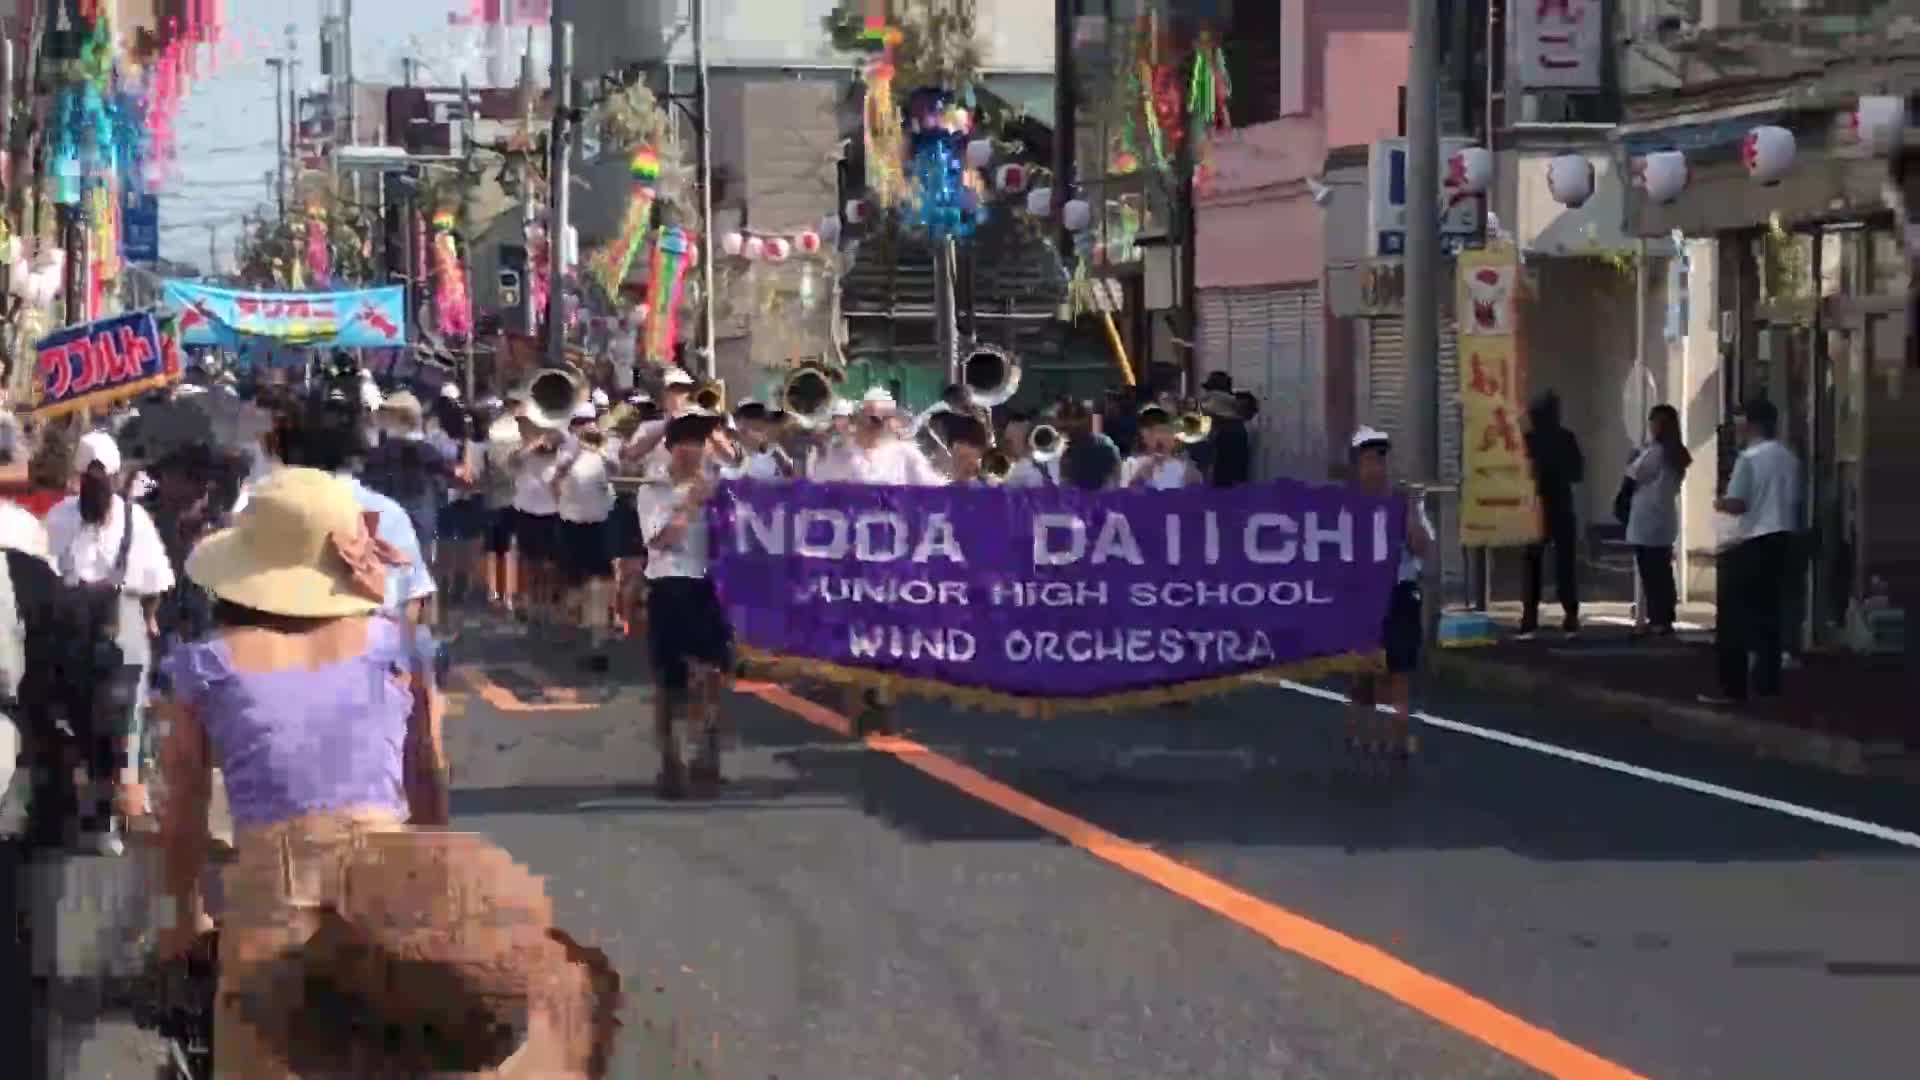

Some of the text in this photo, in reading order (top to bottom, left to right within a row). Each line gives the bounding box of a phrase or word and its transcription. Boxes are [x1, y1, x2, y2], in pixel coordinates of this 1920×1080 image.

[1033, 509, 1390, 567] DAIICHI
[1129, 580, 1334, 607] SCHOOL
[850, 626, 1275, 663] WIND ORCHESTRA
